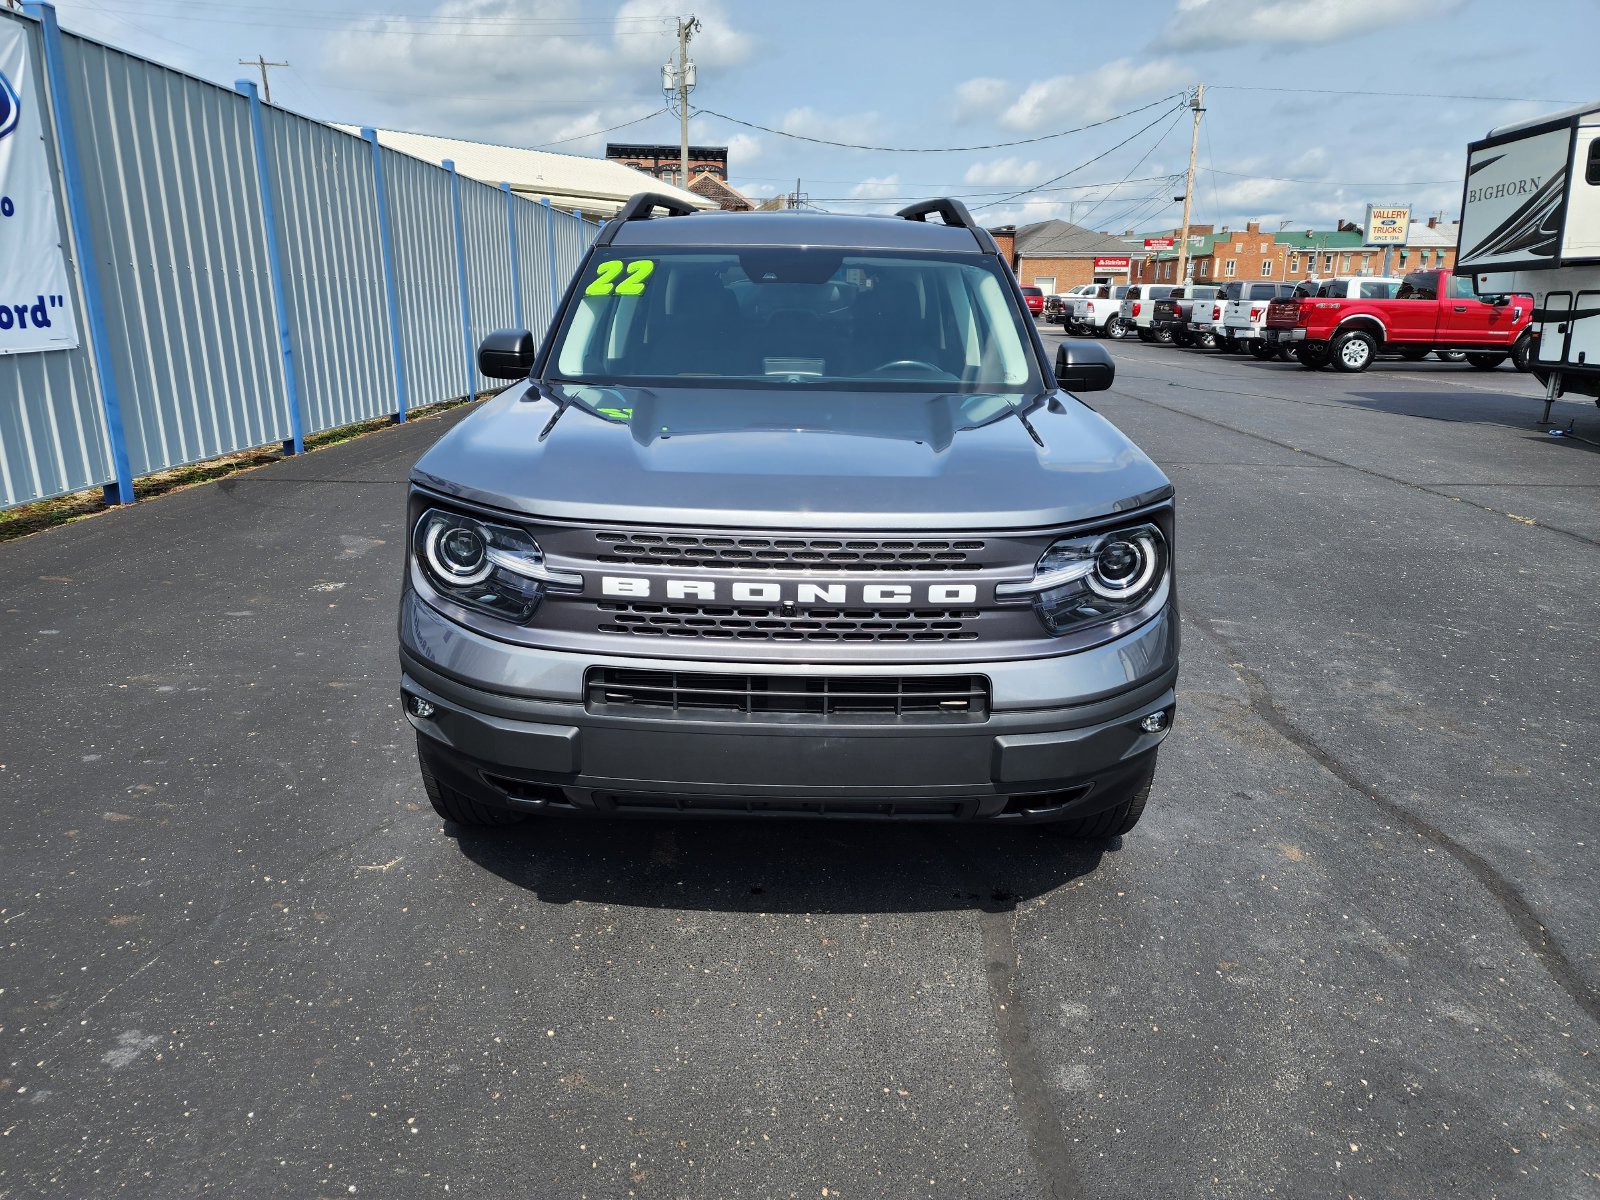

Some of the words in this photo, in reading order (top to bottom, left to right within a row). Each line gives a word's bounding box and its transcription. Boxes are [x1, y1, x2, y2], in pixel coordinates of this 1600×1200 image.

[1468, 176, 1541, 203] BIGHORN
[1373, 210, 1407, 219] VALLERY
[585, 259, 654, 296] 22
[601, 575, 977, 605] BRONCO
